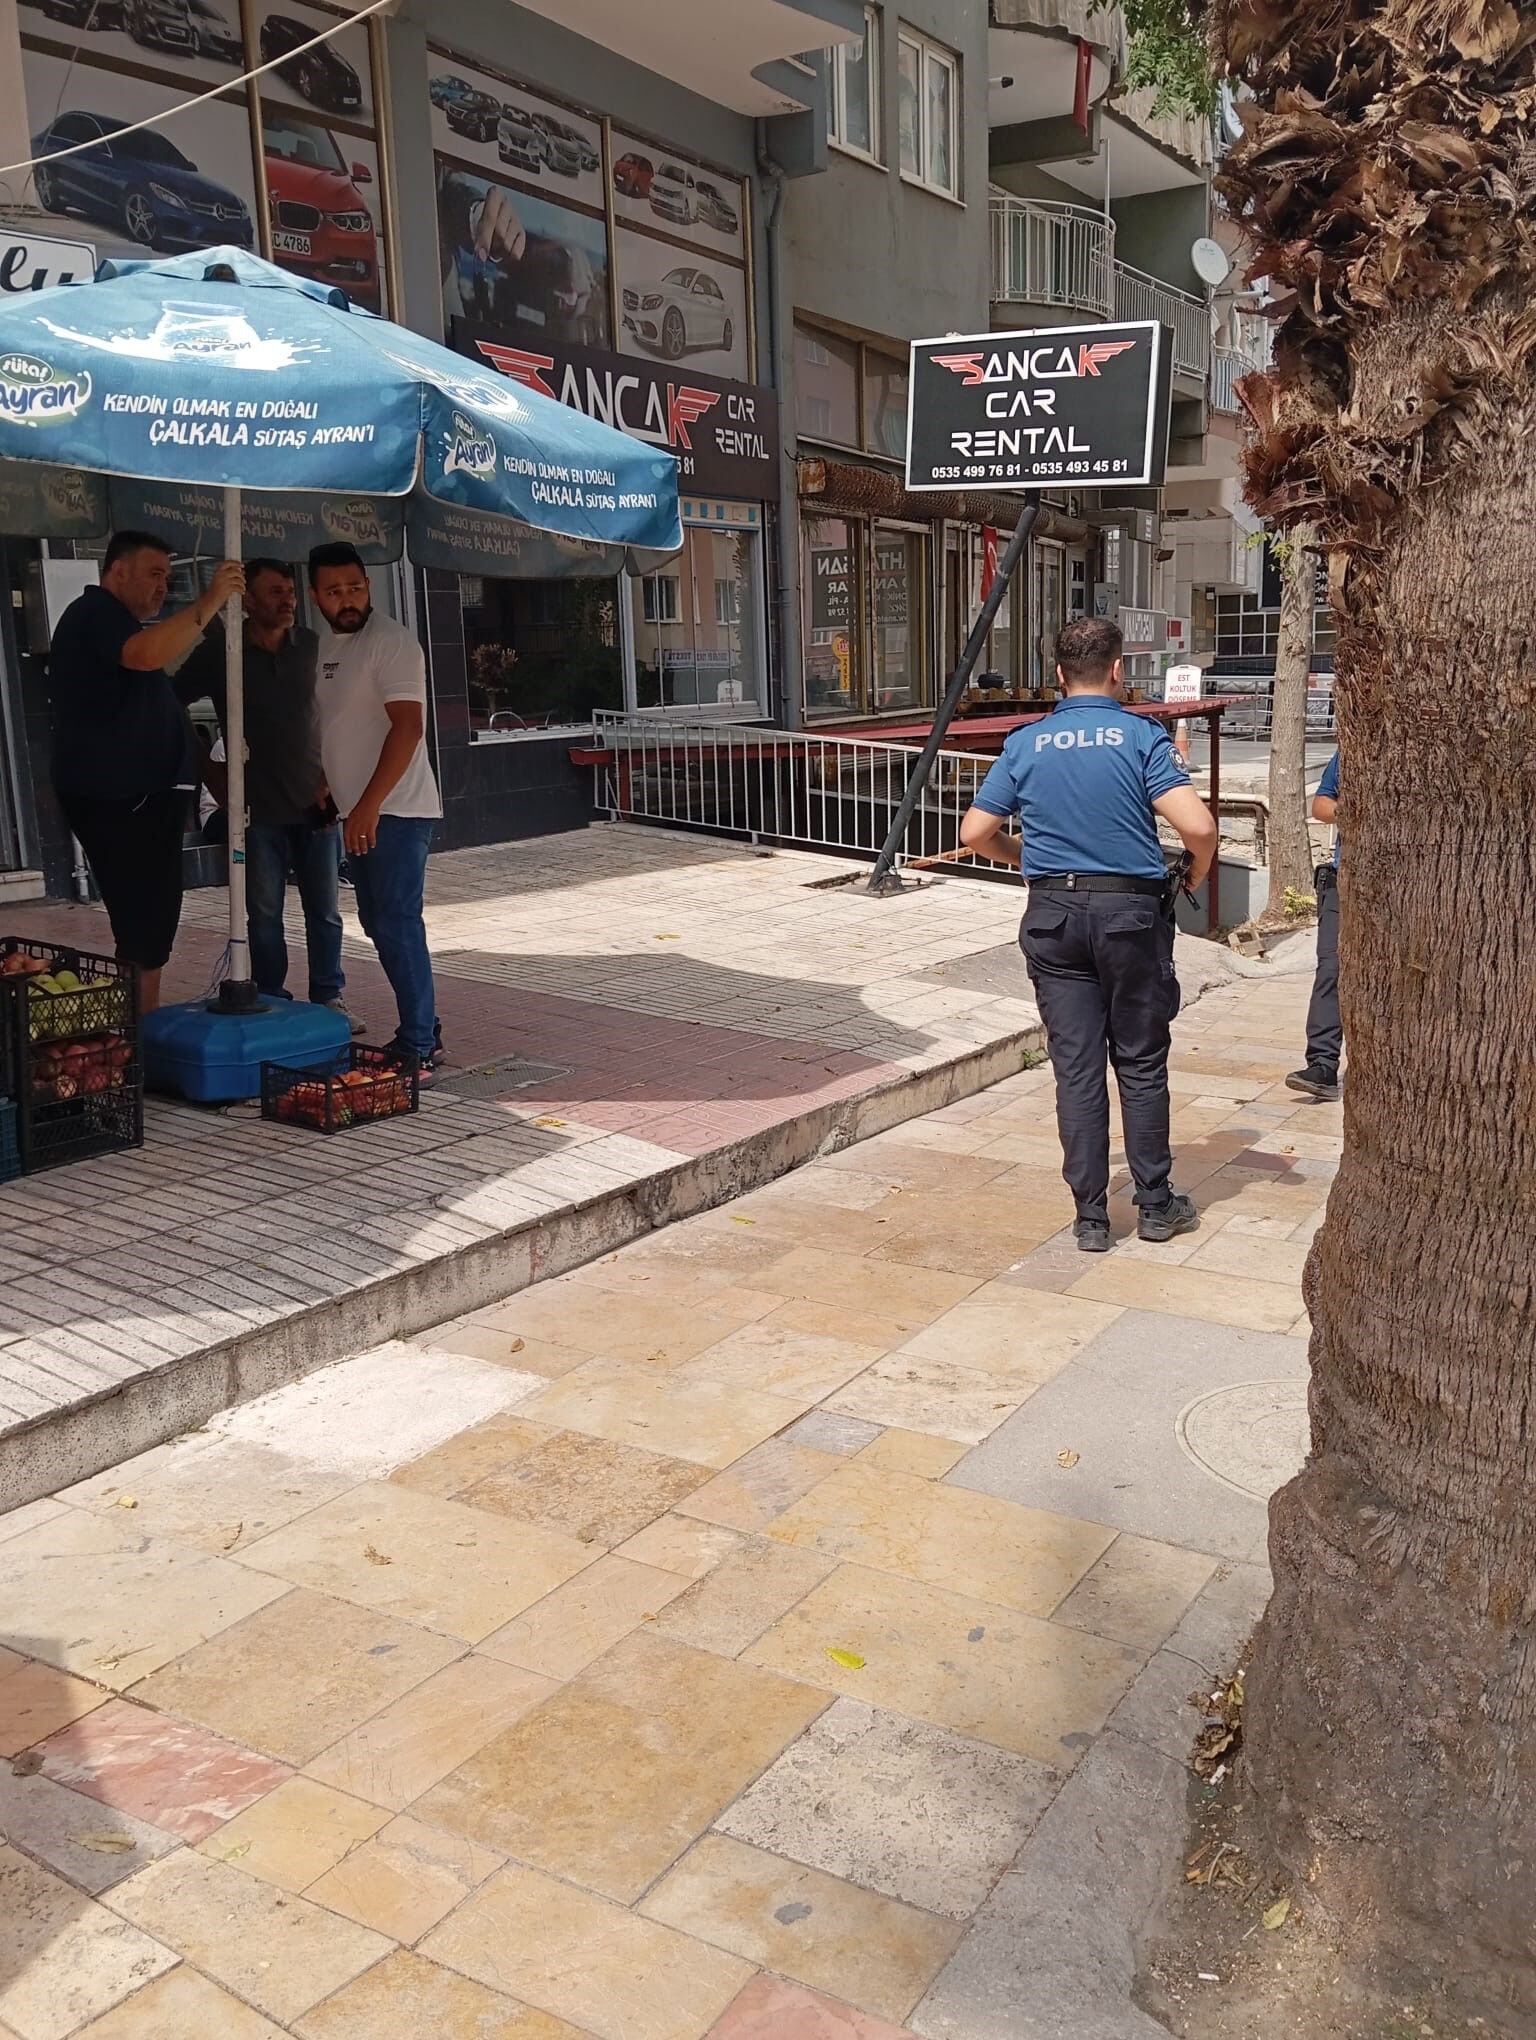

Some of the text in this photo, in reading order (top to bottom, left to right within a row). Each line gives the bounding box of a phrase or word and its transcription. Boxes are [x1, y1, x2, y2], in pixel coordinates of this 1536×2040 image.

[283, 235, 310, 253] 4786
[929, 341, 1136, 385] SANCAK
[103, 393, 318, 420] KENDİN OLMAK EN DOĞALI
[728, 395, 755, 423] CAR
[986, 389, 1056, 418] CAR
[150, 420, 248, 446] ÇALKALA
[254, 427, 305, 450] SÜTAŞ
[715, 428, 769, 459] RENTAL
[951, 426, 1090, 457] RENTAL
[455, 437, 491, 468] Ayran
[684, 457, 694, 475] 81
[503, 455, 616, 487] KENDİN OLMAK EN DOĞALI
[932, 466, 960, 478] 0535
[963, 465, 984, 477] 499
[989, 464, 1003, 476] 76
[1006, 464, 1021, 476] 81
[1033, 462, 1062, 475] 0535
[1066, 461, 1089, 473] 493
[1093, 460, 1109, 472] 45
[1113, 459, 1128, 471] 81
[531, 481, 584, 507] ÇALKALA
[586, 493, 616, 512] SÜTAŞ
